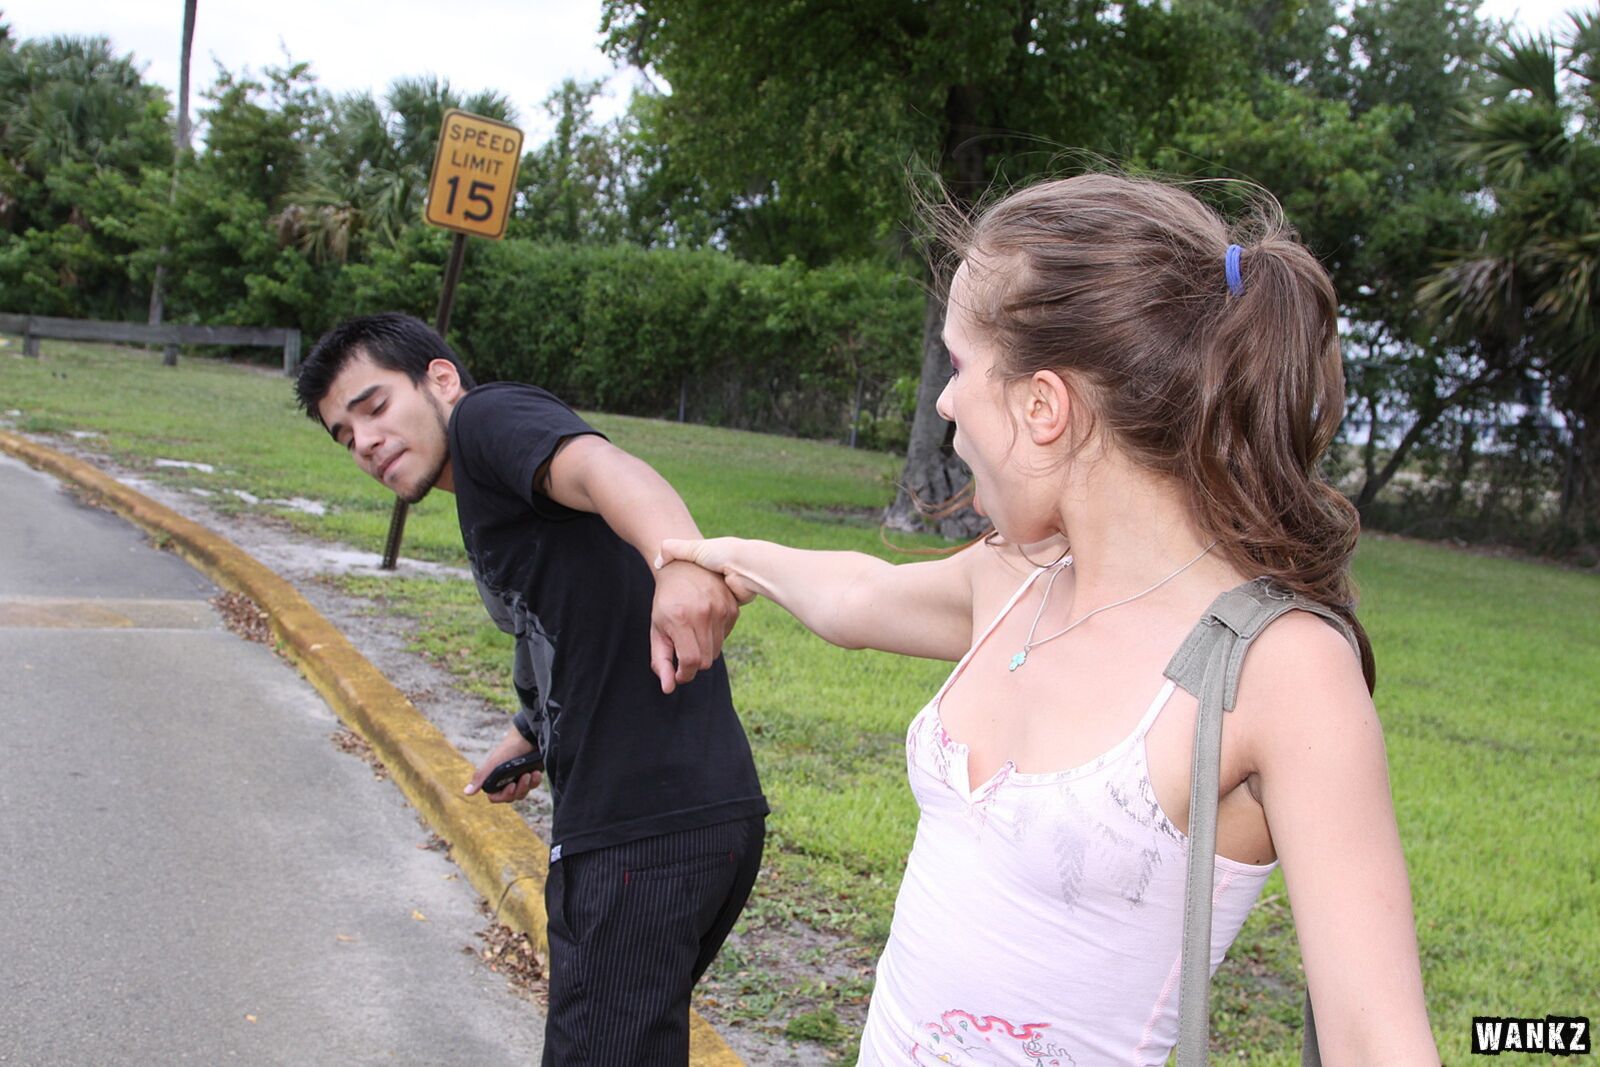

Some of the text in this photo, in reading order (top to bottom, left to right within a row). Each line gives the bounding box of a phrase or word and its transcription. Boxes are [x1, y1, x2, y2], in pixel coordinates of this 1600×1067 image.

[450, 124, 516, 154] SPEED
[451, 150, 504, 175] LIMIT
[446, 176, 496, 222] 15
